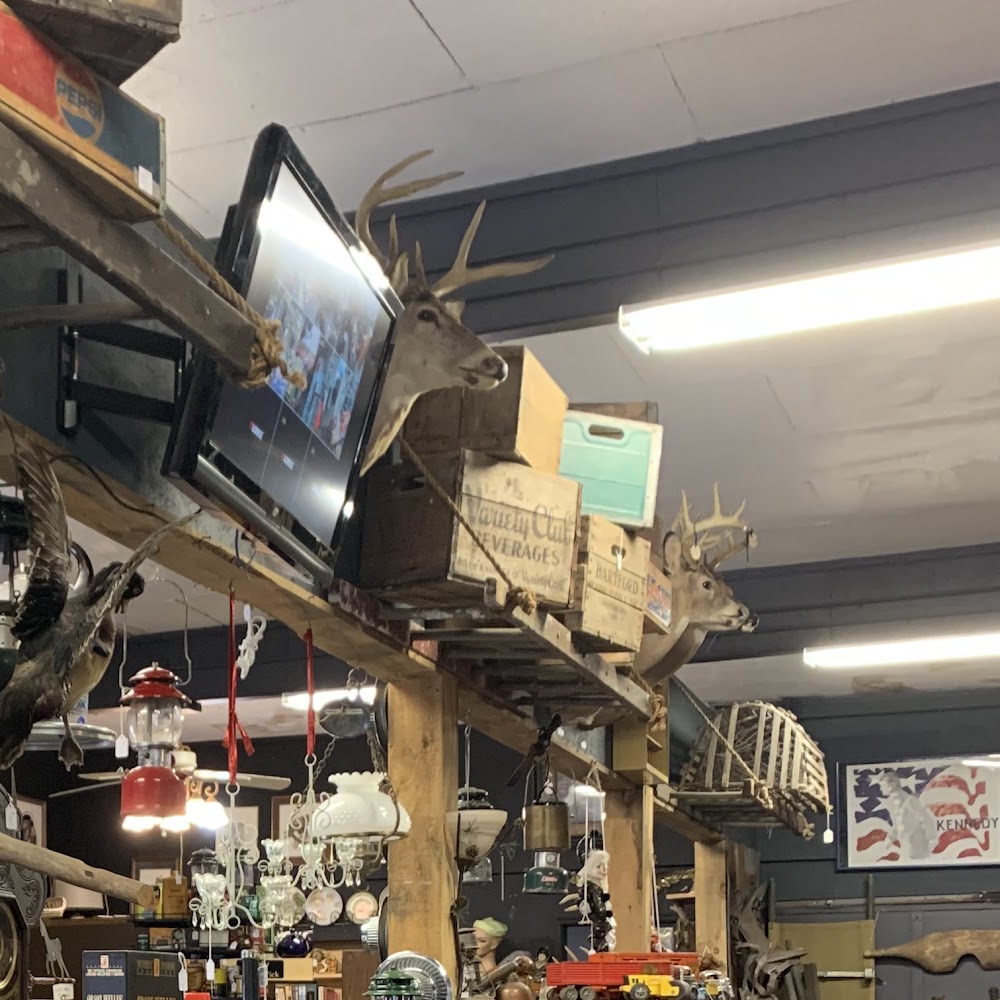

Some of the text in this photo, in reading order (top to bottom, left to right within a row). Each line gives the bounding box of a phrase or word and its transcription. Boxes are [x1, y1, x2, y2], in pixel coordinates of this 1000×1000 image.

[56, 78, 101, 122] PEPSI
[464, 483, 574, 546] Variety Club
[596, 562, 640, 596] HARTFORD
[936, 817, 999, 832] KENNEDY
